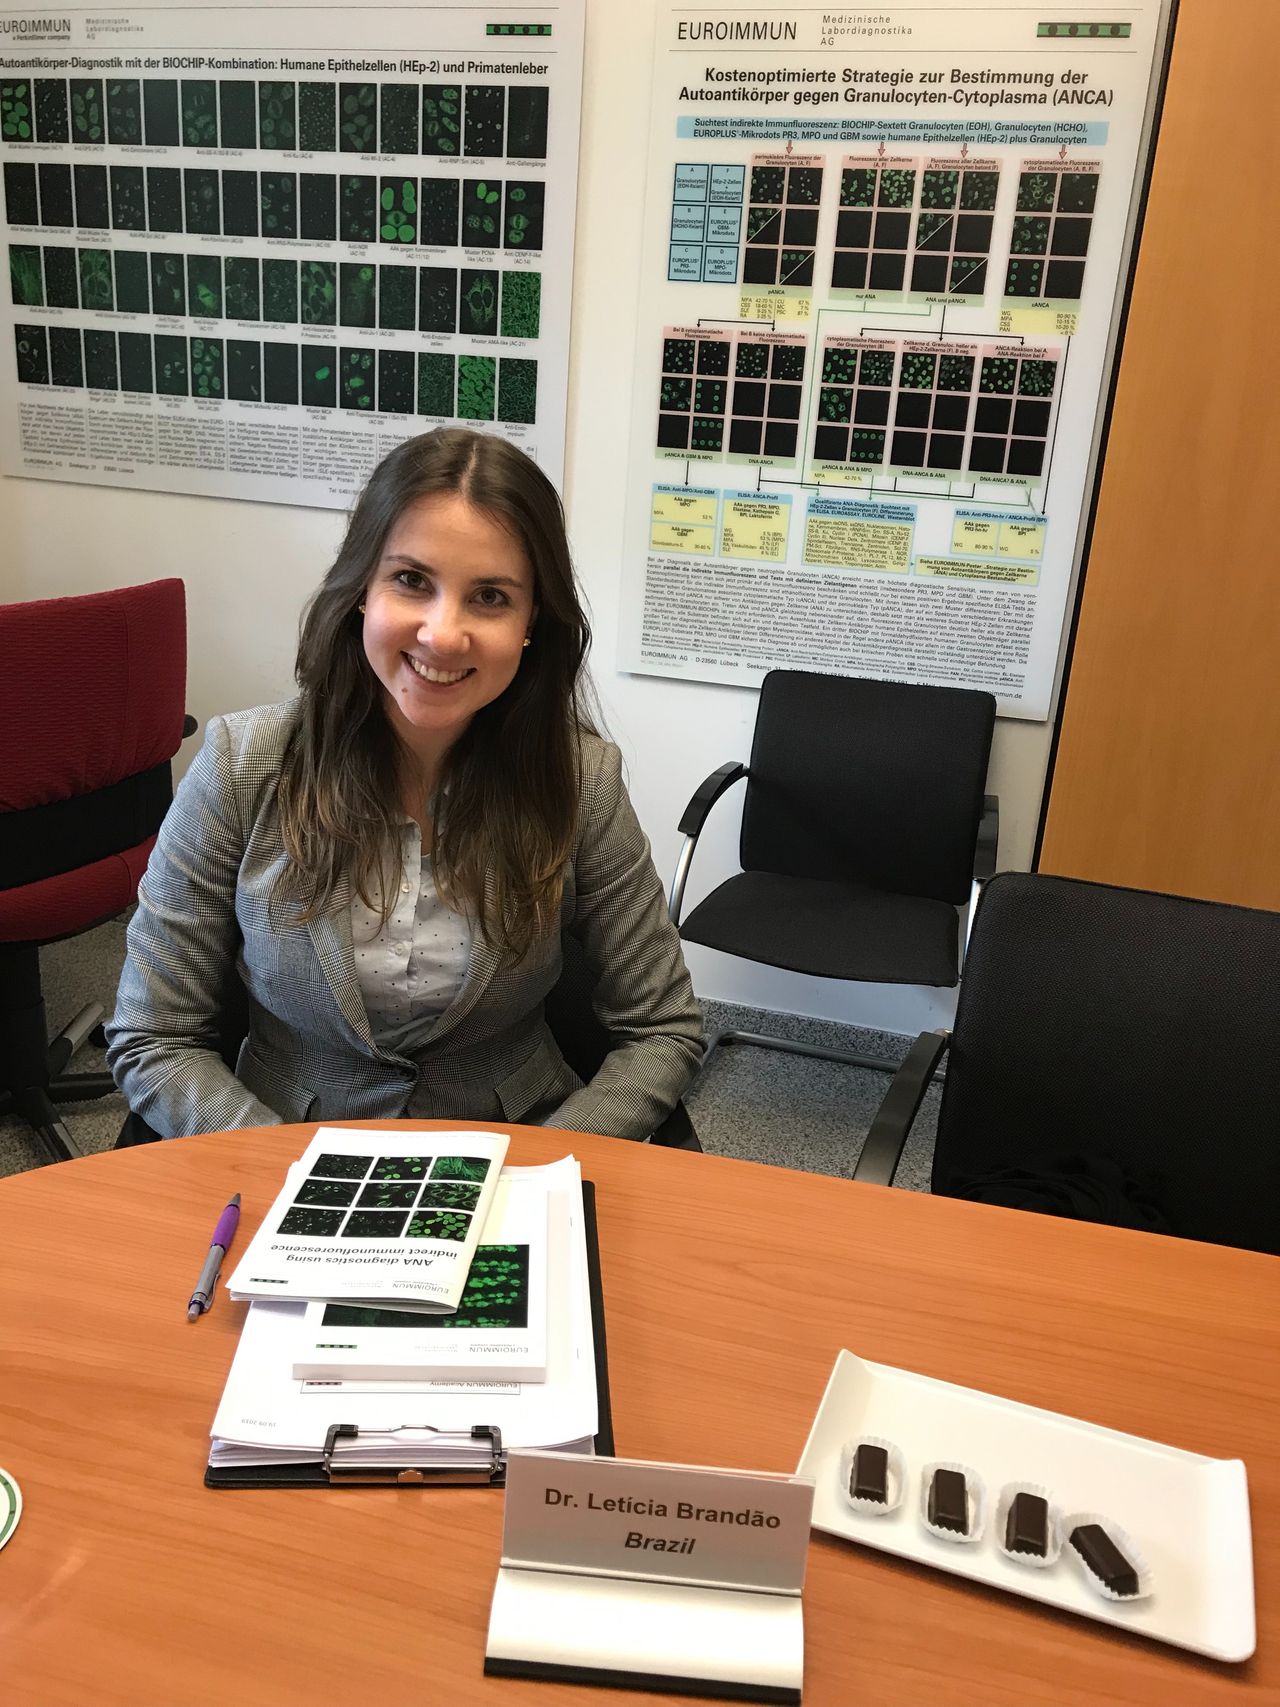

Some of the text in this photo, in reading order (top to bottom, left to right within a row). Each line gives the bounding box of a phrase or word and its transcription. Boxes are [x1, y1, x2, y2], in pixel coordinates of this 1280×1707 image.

[822, 14, 890, 23] Medizinische
[678, 21, 796, 40] EUROIMMUN
[821, 26, 912, 36] Labordiagnostika
[820, 37, 834, 45] AG
[0, 56, 548, 74] Autoantikörper-Diagnostik mit der BIOCHIP-Kombination: Humane Epithelzellen (HEp-2) und Primatenleber
[705, 67, 1088, 87] Kostenoptimierte Strategie zur Bestimmung der
[678, 87, 1113, 106] Autoantikörper gegen Granulocyten-Cytoplasma (ANCA)
[694, 118, 1087, 132] Suchtest indirekte Immunfluoreszenz: BIOCHIP-Sextett Granulocyten (EOH), Granulocyten (HCHO),
[801, 130, 821, 139] MPO
[822, 131, 838, 140] und
[839, 131, 860, 140] GBM
[861, 132, 886, 143] sowie
[887, 132, 921, 141] humane
[922, 132, 975, 144] Epithelzellen
[976, 133, 1008, 144] (HEp-2)
[1009, 134, 1027, 144] plus
[1029, 134, 1087, 145] Granulocyten
[934, 610, 1033, 625] Spektrum verschiedener Erkrankungen
[913, 621, 947, 631] Granulocyten
[970, 627, 985, 635] heller
[641, 650, 676, 659] EUROIMMUN
[956, 645, 1001, 656] Gastroenterologie
[1014, 651, 1028, 659] Rolle
[695, 656, 738, 667] D-23560 Lübeck
[746, 662, 772, 672] Seekamp
[270, 1245, 457, 1259] indirect immunofluorescence
[286, 1255, 434, 1266] ANA diagnostics using
[392, 1283, 449, 1294] EUROIMMUN
[465, 1380, 520, 1388] EUROIMMUN
[544, 1488, 780, 1528] Dr. Letícia Brandão
[624, 1531, 696, 1554] Brazil
